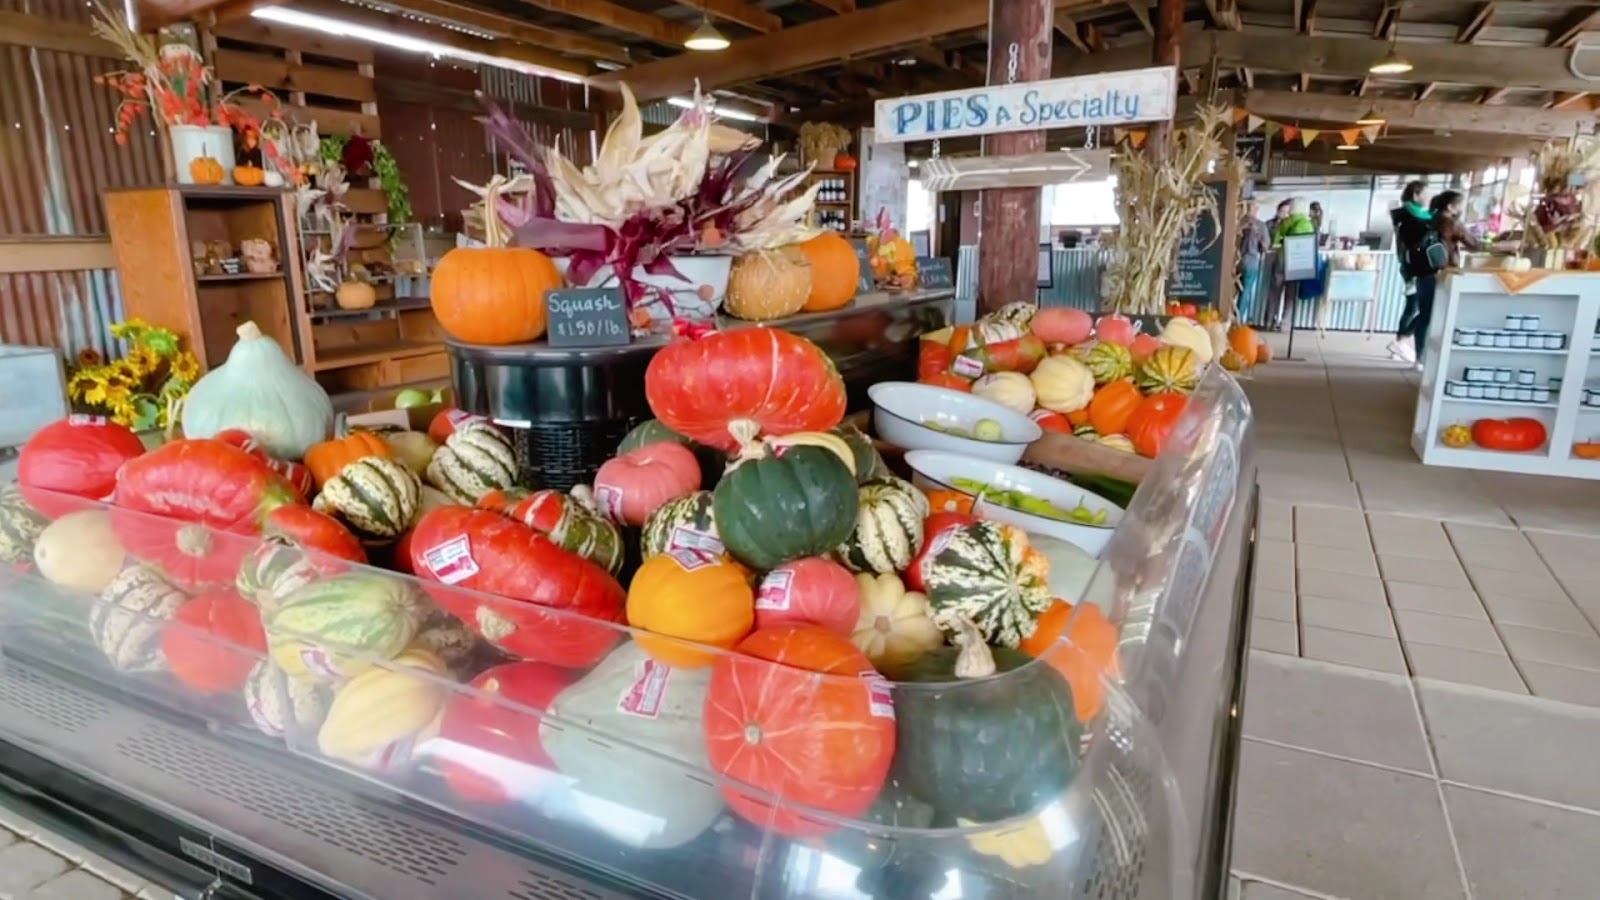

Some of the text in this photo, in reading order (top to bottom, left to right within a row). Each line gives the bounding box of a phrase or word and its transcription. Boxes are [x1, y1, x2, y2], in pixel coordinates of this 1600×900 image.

[892, 93, 989, 135] PIES
[1019, 89, 1140, 126] Specialty
[548, 292, 621, 319] Squash
